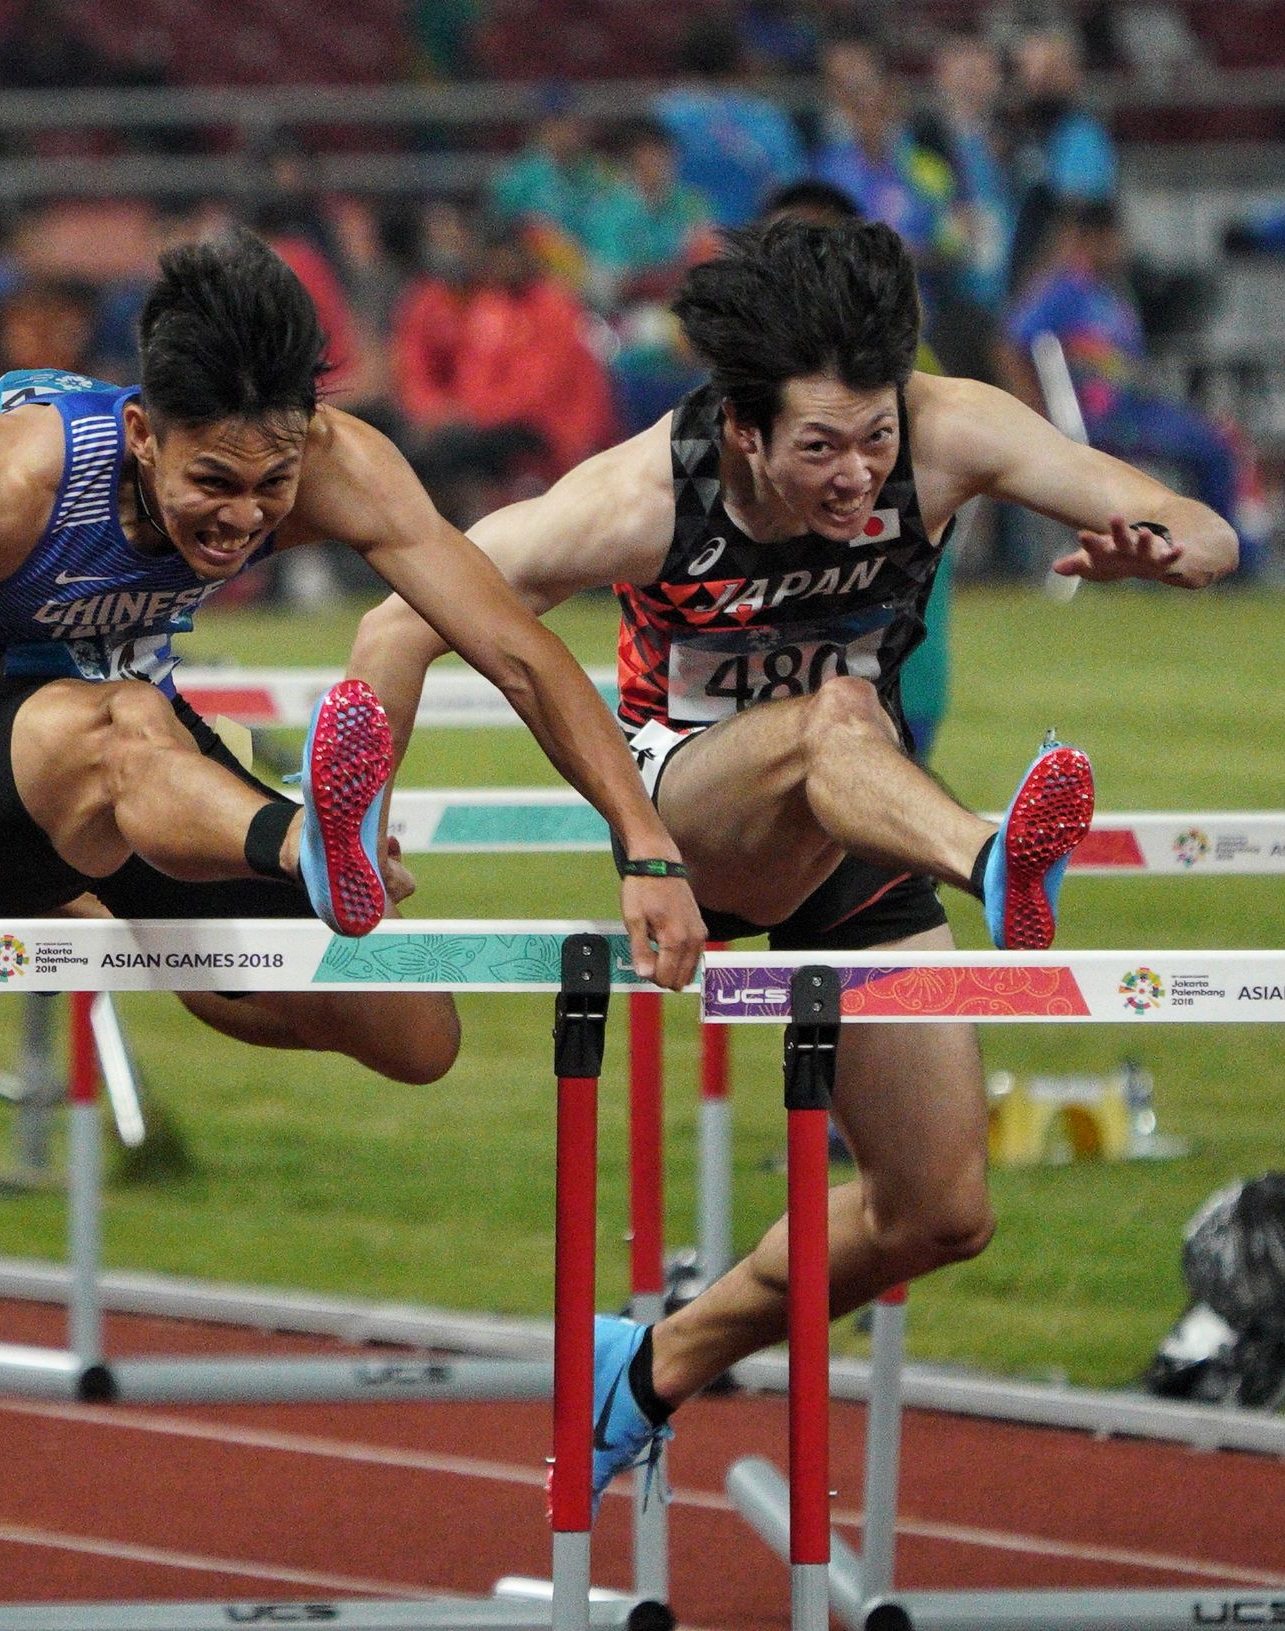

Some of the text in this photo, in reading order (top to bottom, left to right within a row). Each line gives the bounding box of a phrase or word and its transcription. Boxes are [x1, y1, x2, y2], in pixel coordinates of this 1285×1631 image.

[692, 556, 888, 615] JAPAN
[35, 947, 73, 955] Jakarta
[35, 956, 89, 966] Palembang
[100, 952, 284, 969] ASIAN GAMES 2018
[35, 965, 57, 974] 2018
[1171, 980, 1209, 988] Jakarta
[716, 988, 788, 1005] UCS
[1171, 989, 1226, 998] Palembang
[1237, 985, 1285, 1001] ASIA
[1171, 998, 1194, 1006] 2018
[226, 1603, 338, 1623] UCS
